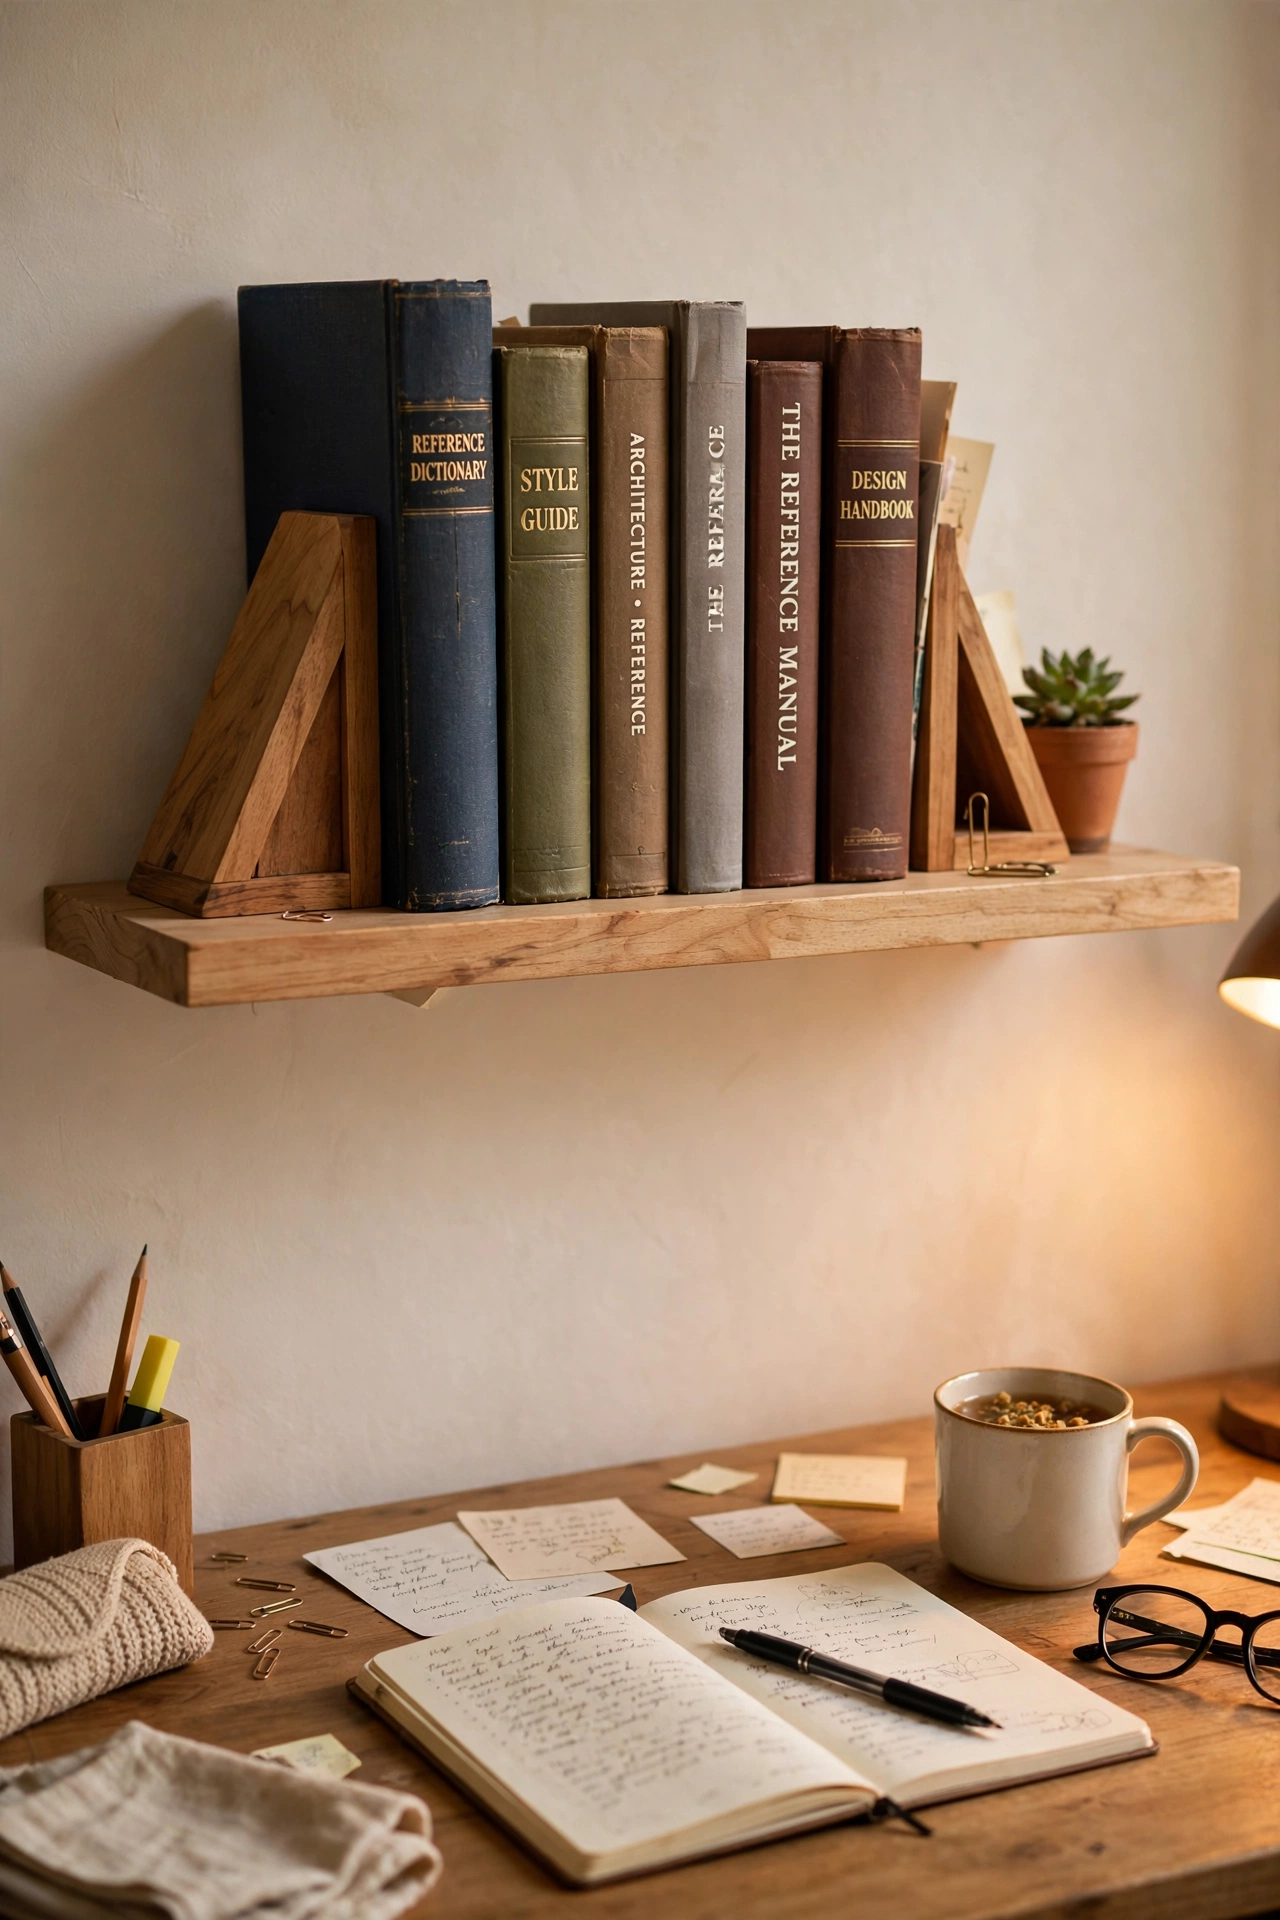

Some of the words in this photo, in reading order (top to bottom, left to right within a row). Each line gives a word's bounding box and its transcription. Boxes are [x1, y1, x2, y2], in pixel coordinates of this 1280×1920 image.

[412, 432, 486, 454] REFERENCE
[781, 402, 801, 461] THE
[410, 460, 488, 482] DICTIONARY
[520, 467, 579, 493] STYLE
[851, 470, 908, 491] DESIGN
[520, 506, 580, 532] GUIDE
[629, 432, 646, 590] ARCHITECTURE
[840, 499, 915, 520] HANDBOOK
[779, 471, 800, 633] REFERENCE
[630, 618, 646, 736] REFERENCE
[777, 645, 799, 771] MANUAL
